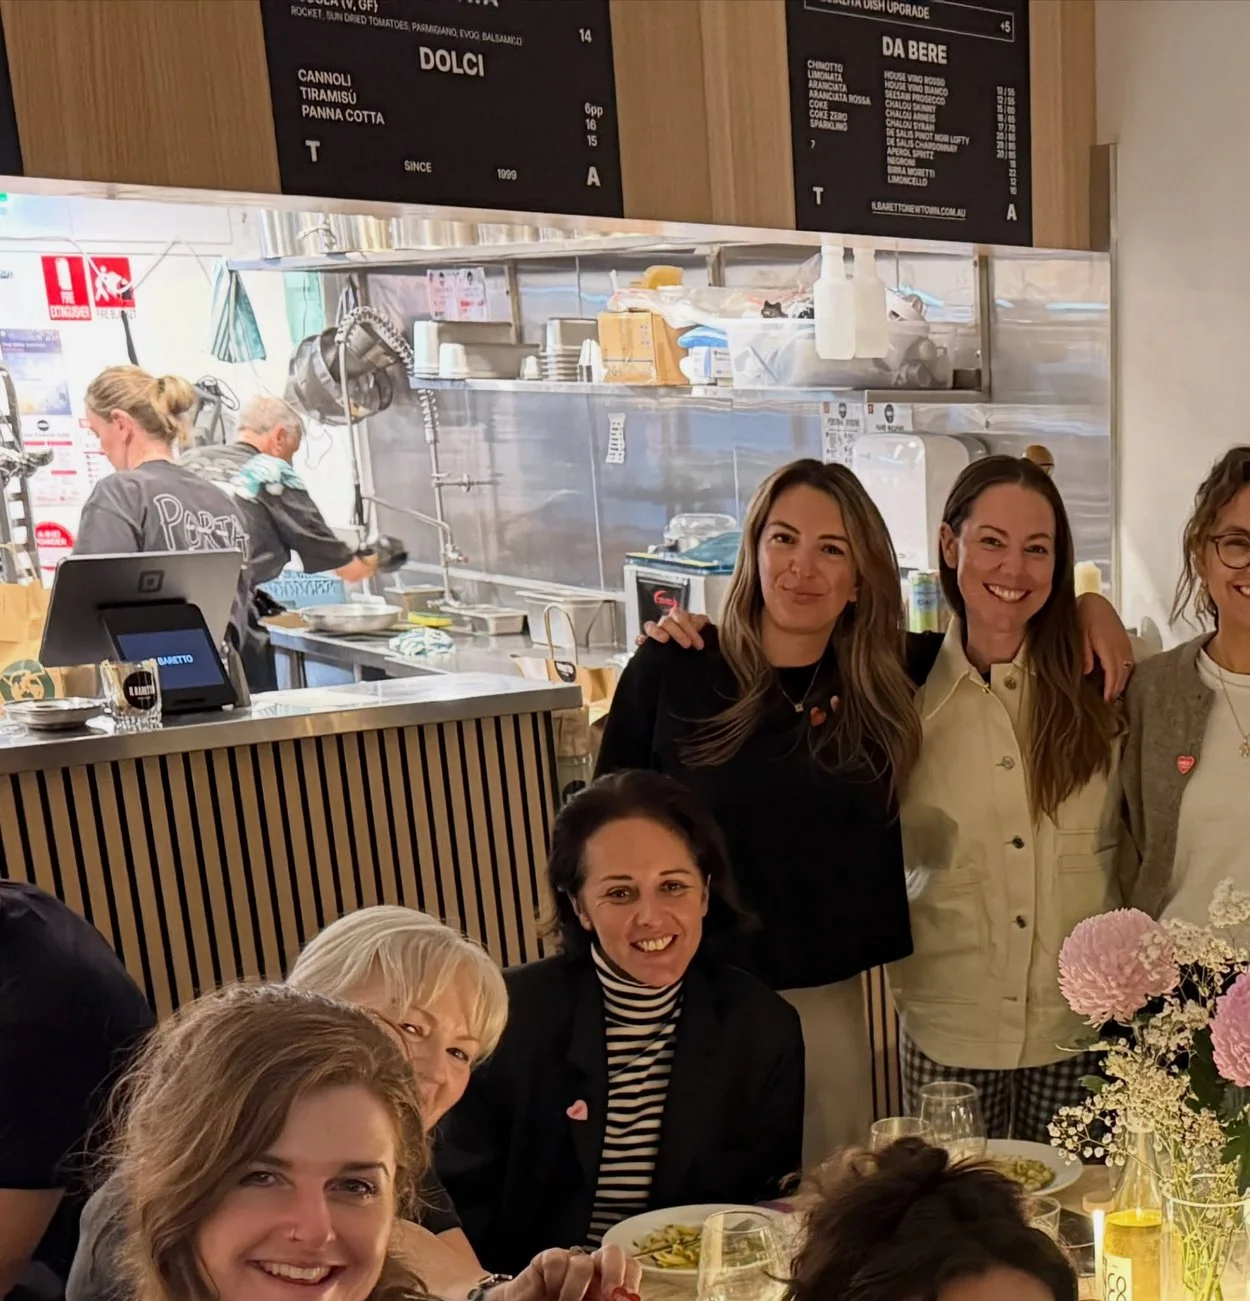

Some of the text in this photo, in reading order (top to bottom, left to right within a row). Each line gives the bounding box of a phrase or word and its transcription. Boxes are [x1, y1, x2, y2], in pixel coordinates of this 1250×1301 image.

[887, 1, 930, 19] UPGRADE
[1000, 20, 1011, 33] +5
[578, 28, 593, 44] 14
[882, 36, 947, 64] DA BERE
[419, 46, 485, 77] DOLCI
[807, 60, 843, 73] CHINOTTO
[298, 69, 352, 87] CANNOLI
[584, 102, 604, 118] 6pp
[809, 100, 828, 110] COKE
[302, 105, 385, 125] PANNA COTTA
[809, 109, 829, 120] COKE
[587, 135, 598, 147] 15
[305, 140, 321, 162] T
[404, 160, 432, 174] SINCE
[497, 168, 517, 181] 1999
[587, 166, 601, 187] A
[813, 187, 824, 205] T
[1006, 203, 1018, 221] A
[157, 654, 194, 666] BARETTO
